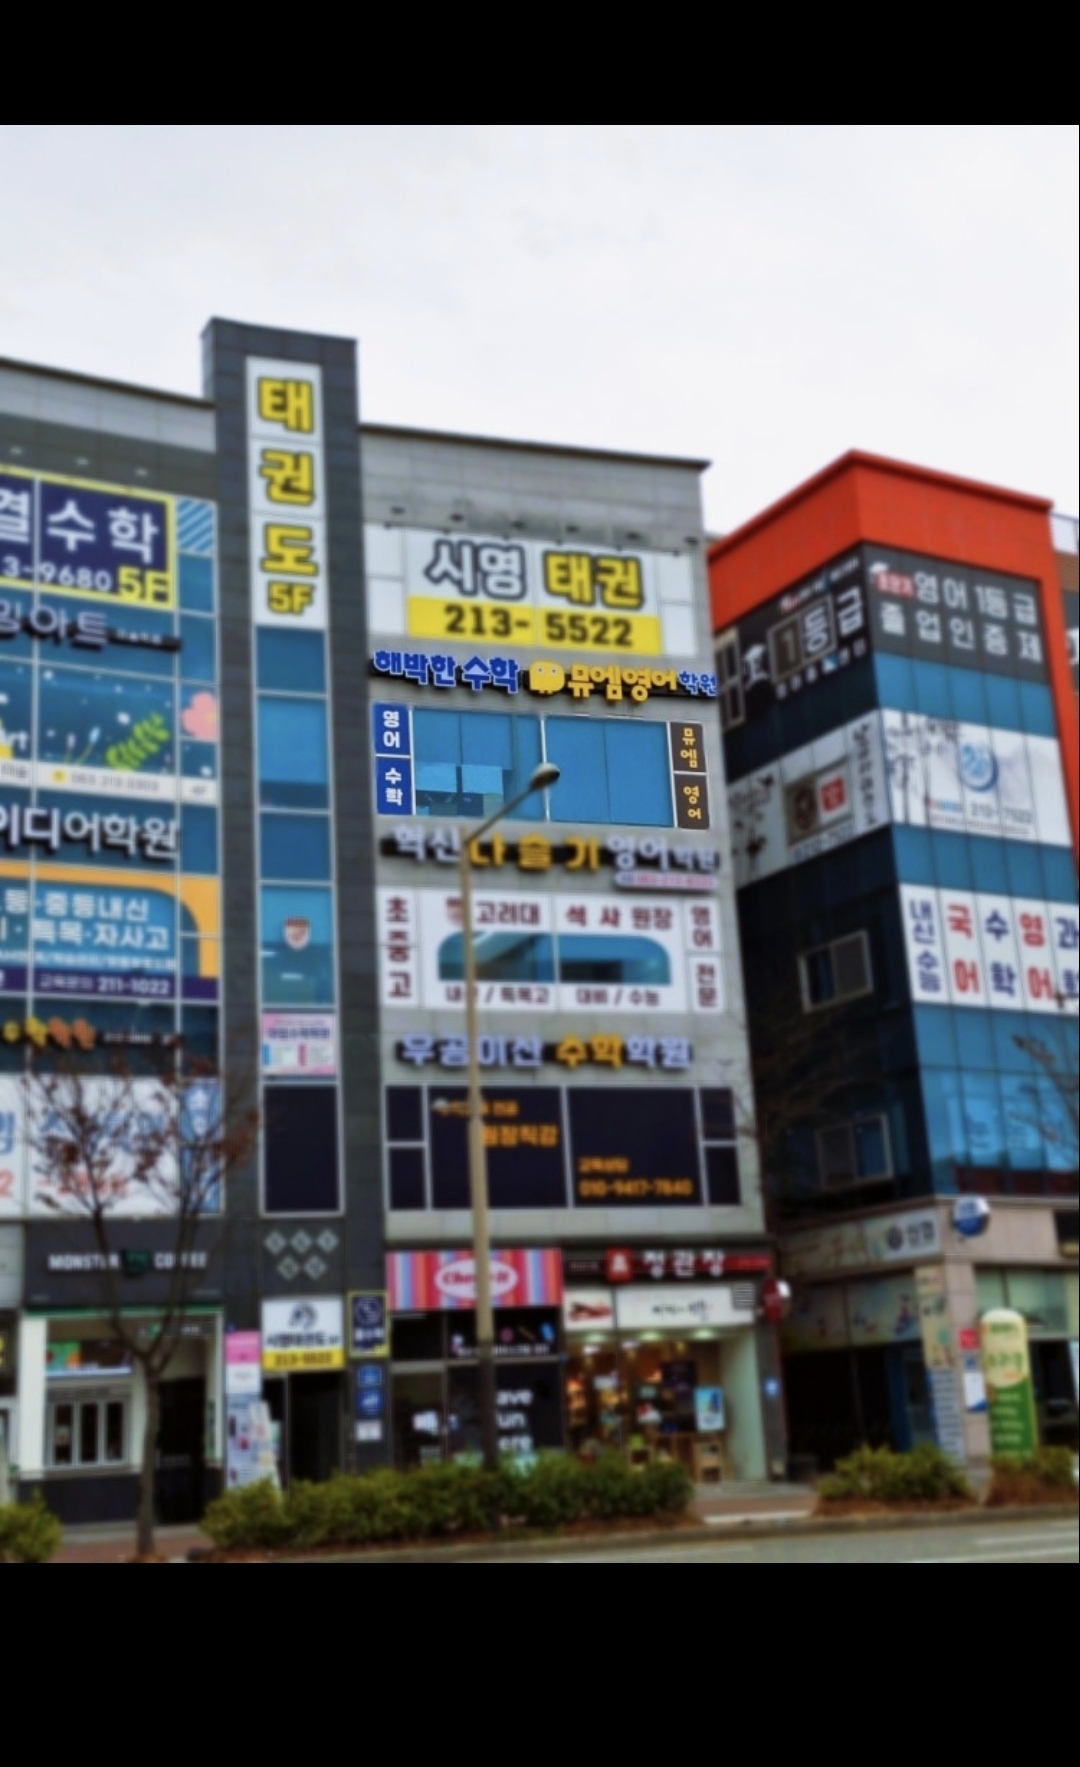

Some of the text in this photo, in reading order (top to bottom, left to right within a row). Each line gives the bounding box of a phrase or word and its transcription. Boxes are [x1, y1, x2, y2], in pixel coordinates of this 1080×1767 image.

[257, 377, 318, 575] 태권도
[424, 539, 644, 609] 시영 태권
[267, 579, 313, 615] 5F
[445, 603, 633, 648] 213- 5522
[373, 650, 456, 686] 해박한
[461, 655, 519, 694] 수학
[383, 710, 401, 748] 영어
[681, 727, 699, 769] 뮤엠
[385, 767, 404, 806] 수학
[683, 785, 702, 820] 영어
[469, 833, 601, 872] 다슬기
[476, 901, 541, 925] 고려대
[690, 906, 714, 948] 영어
[385, 896, 412, 999] 초중고
[98, 976, 171, 995] 211-1022
[696, 962, 717, 1006] 전문
[154, 1252, 207, 1269] COEE
[642, 1250, 725, 1279] 정관장
[496, 1388, 533, 1406] ave
[496, 1411, 527, 1428] un
[497, 1435, 533, 1451] ere
